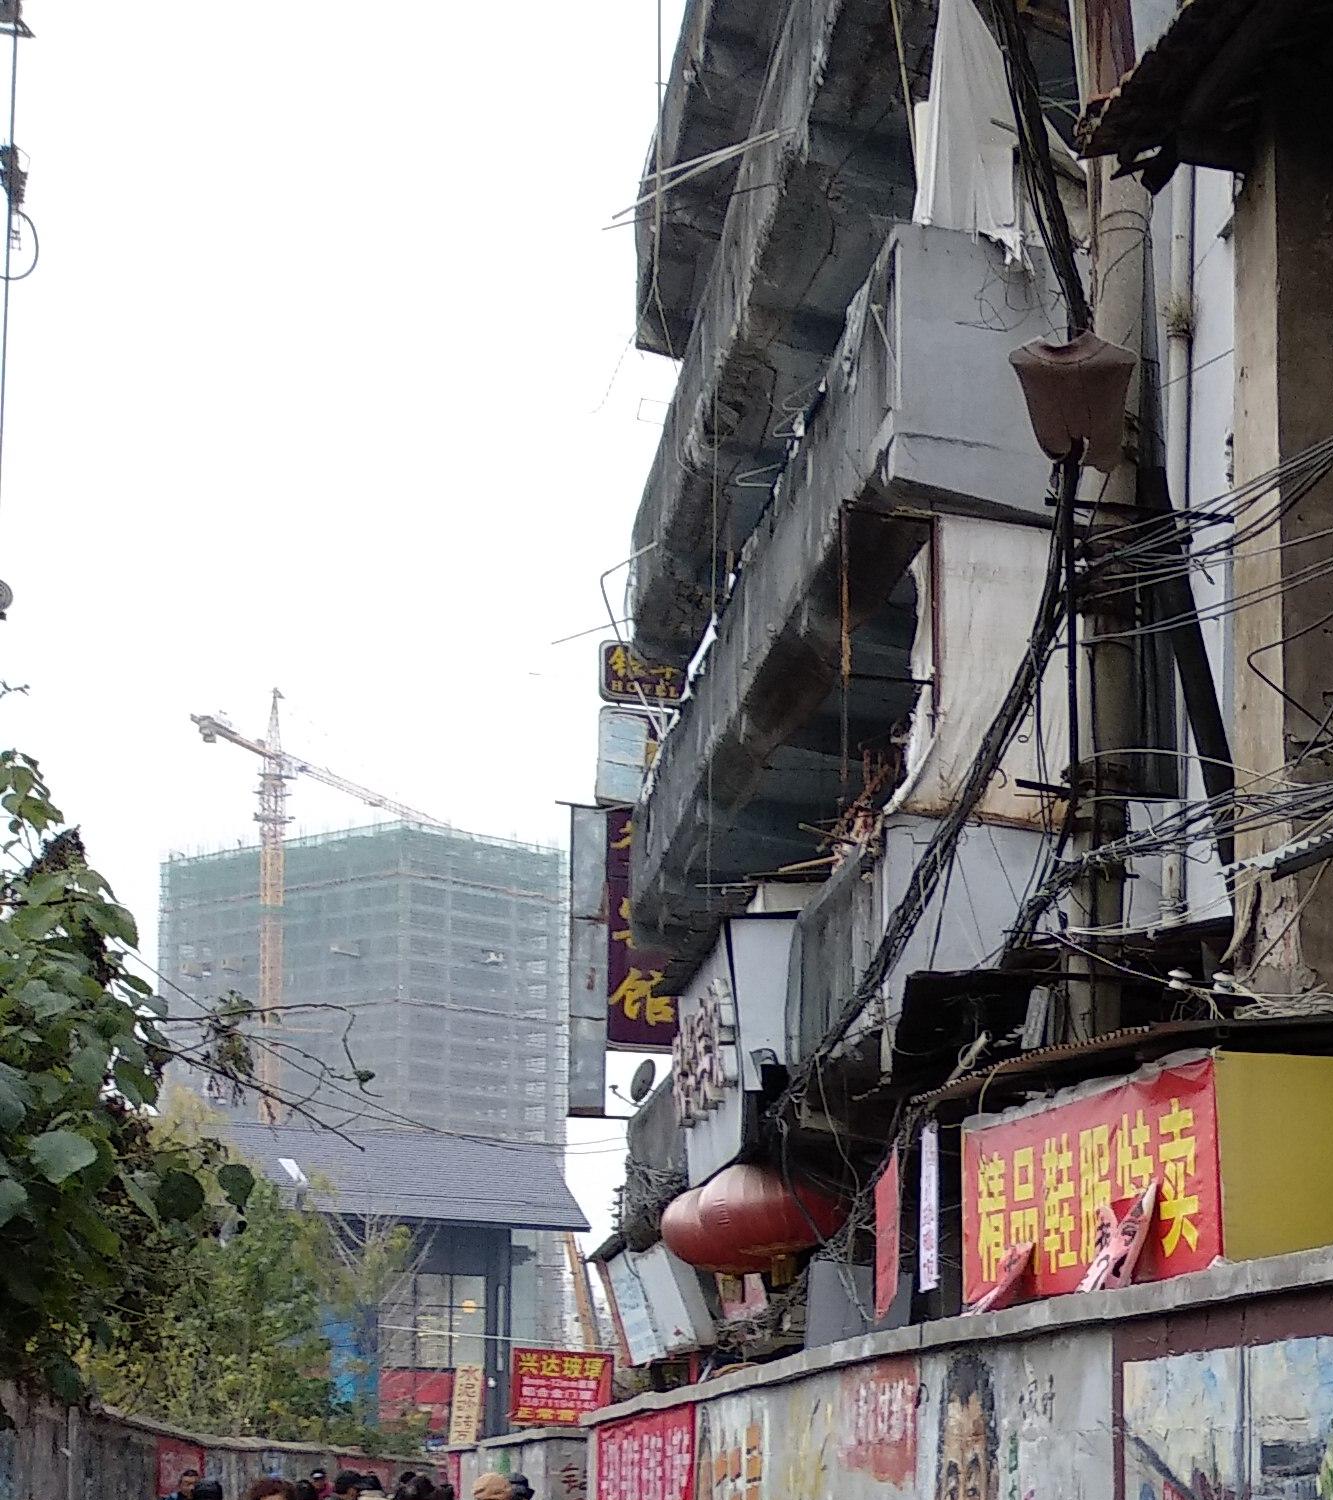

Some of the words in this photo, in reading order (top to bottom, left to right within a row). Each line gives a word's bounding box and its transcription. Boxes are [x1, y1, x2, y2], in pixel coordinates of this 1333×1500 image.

[977, 1098, 1200, 1283] 精品鞋服特卖
[519, 1352, 605, 1380] 兴达玻璃
